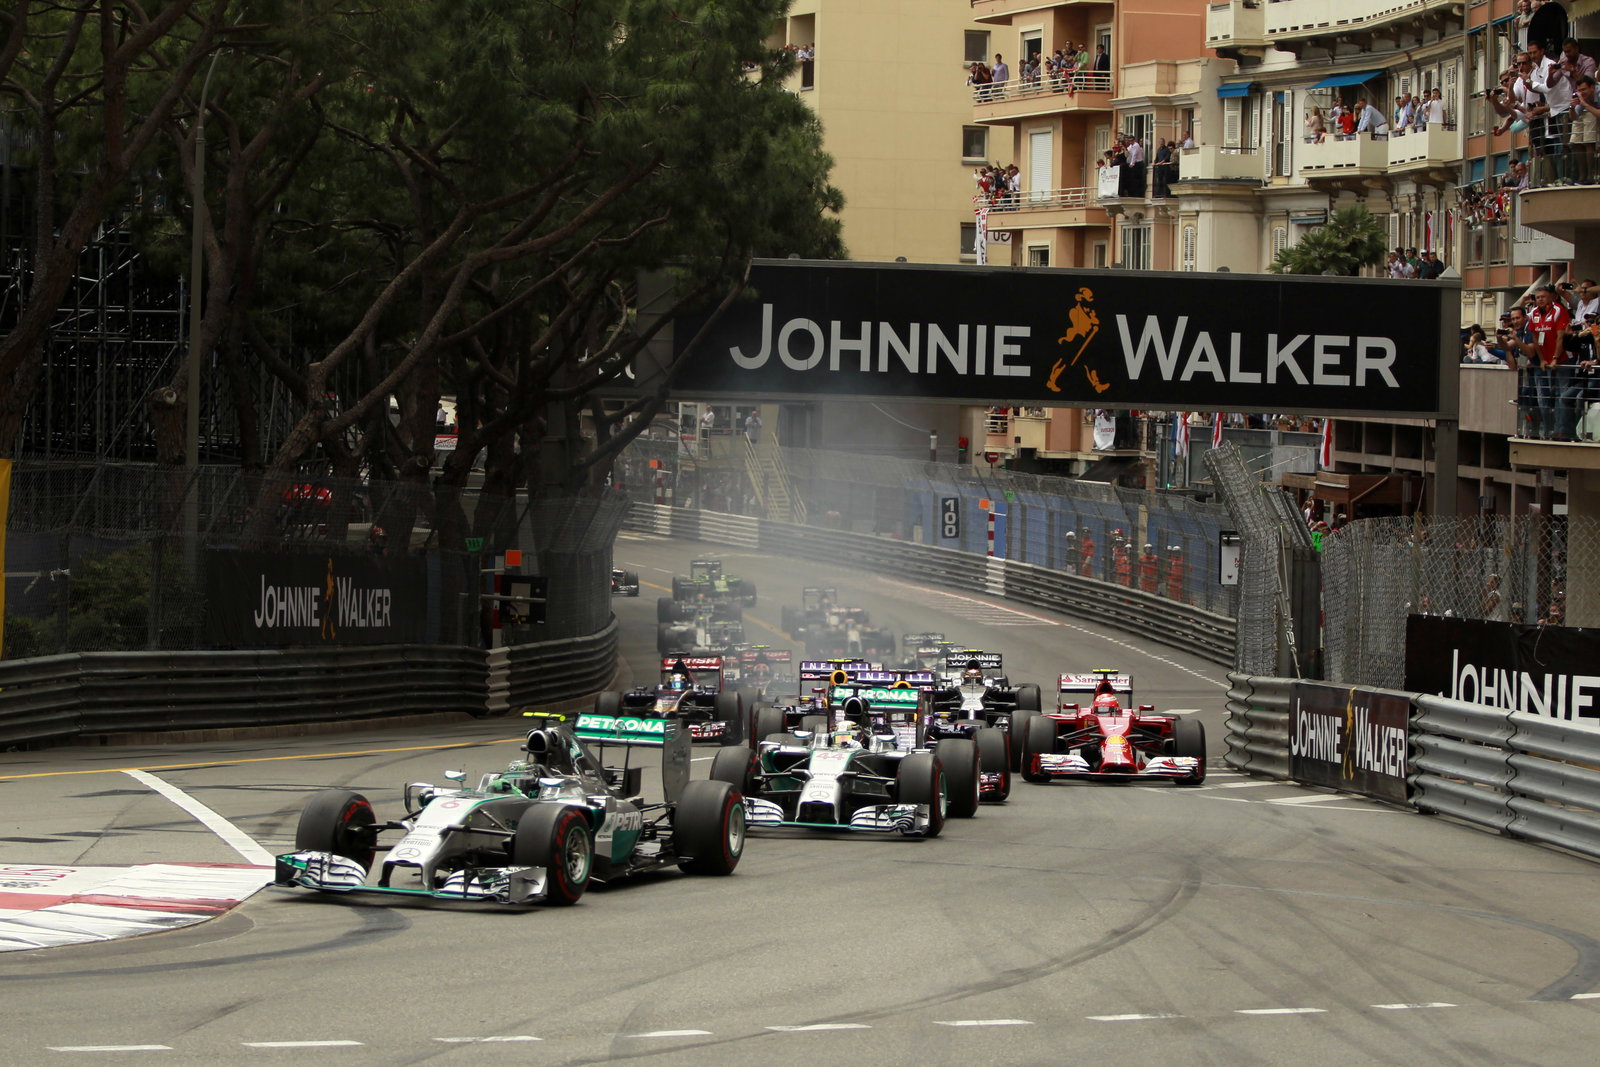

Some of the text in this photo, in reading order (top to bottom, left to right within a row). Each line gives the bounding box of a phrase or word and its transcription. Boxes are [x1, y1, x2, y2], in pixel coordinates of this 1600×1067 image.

[729, 303, 1401, 388] JOHNNIE WALKER
[944, 499, 957, 537] 100
[254, 574, 391, 628] JOHNNIE WALKER
[801, 662, 871, 671] INFIITI
[1074, 674, 1129, 685] Sander
[1438, 648, 1600, 726] JOHNNIE
[1291, 697, 1405, 779] JOHNNIE WALKER
